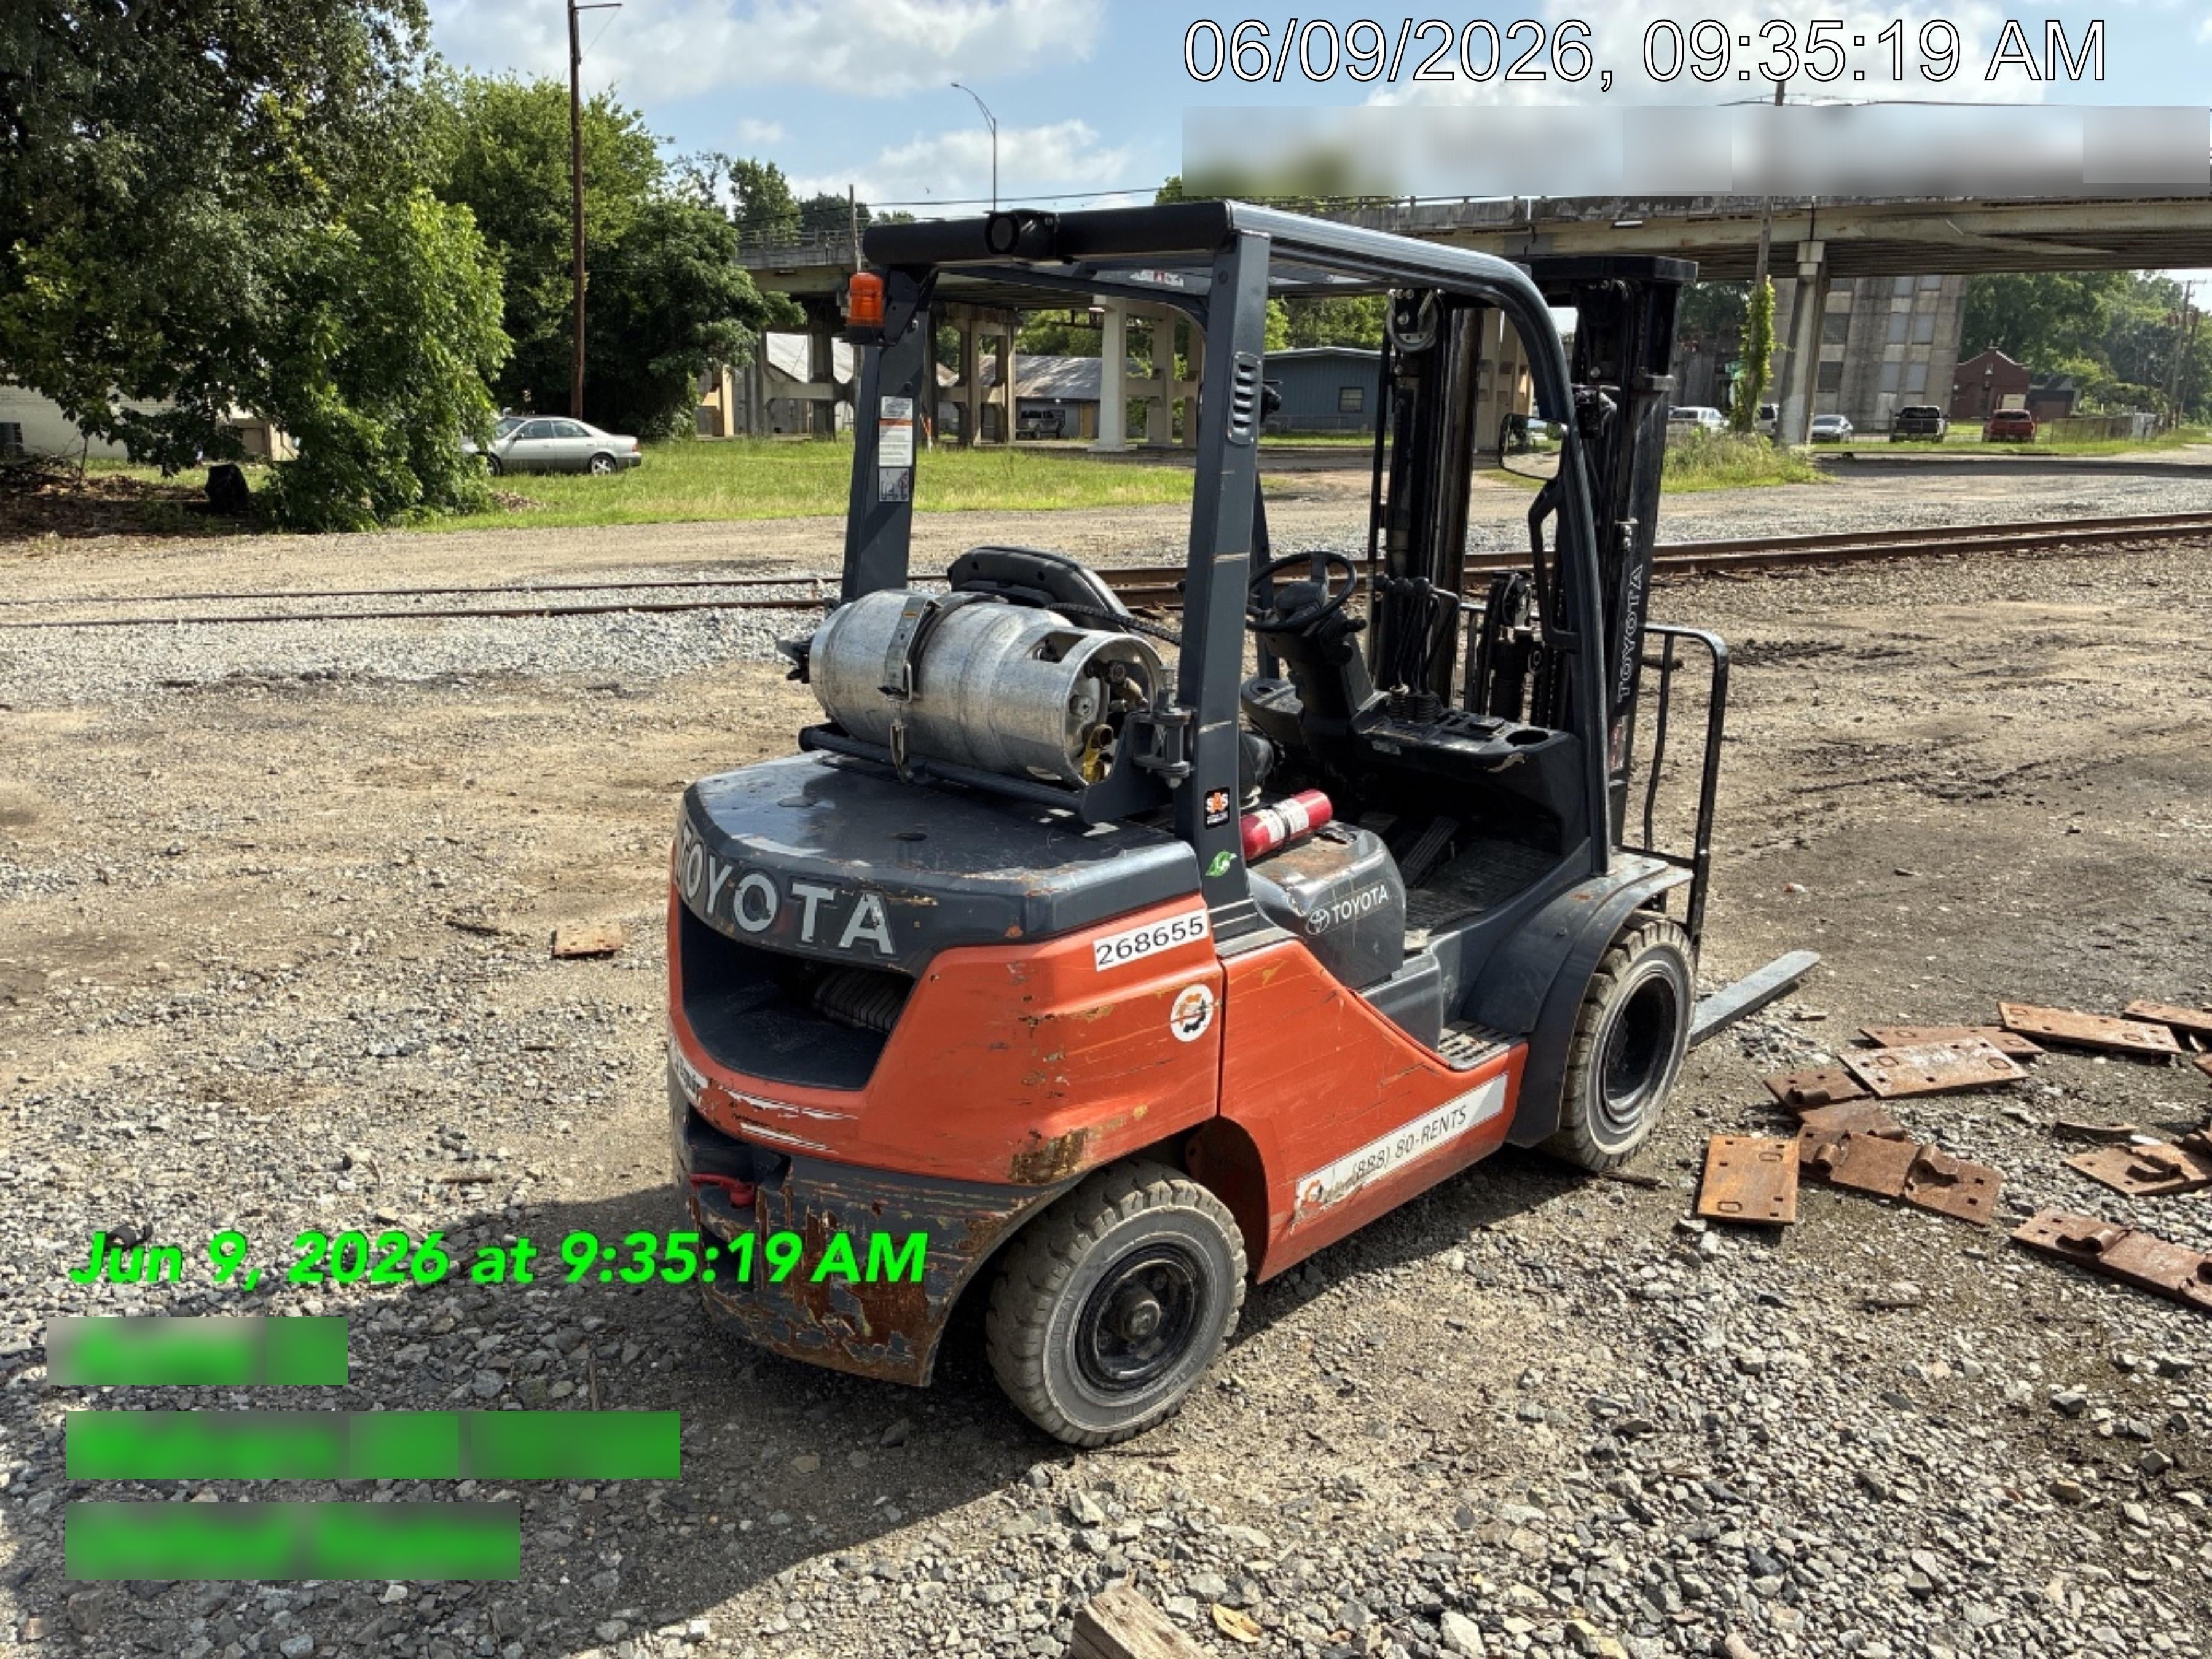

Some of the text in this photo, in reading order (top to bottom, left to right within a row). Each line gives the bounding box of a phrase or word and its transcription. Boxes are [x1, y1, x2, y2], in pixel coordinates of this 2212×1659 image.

[1617, 563, 1644, 703] TOYOTA
[677, 822, 893, 954] TOYOTA
[1331, 884, 1389, 924] TOYOTA
[1097, 916, 1204, 965] 268655
[1352, 1104, 1467, 1181] (888) 80-RENTS
